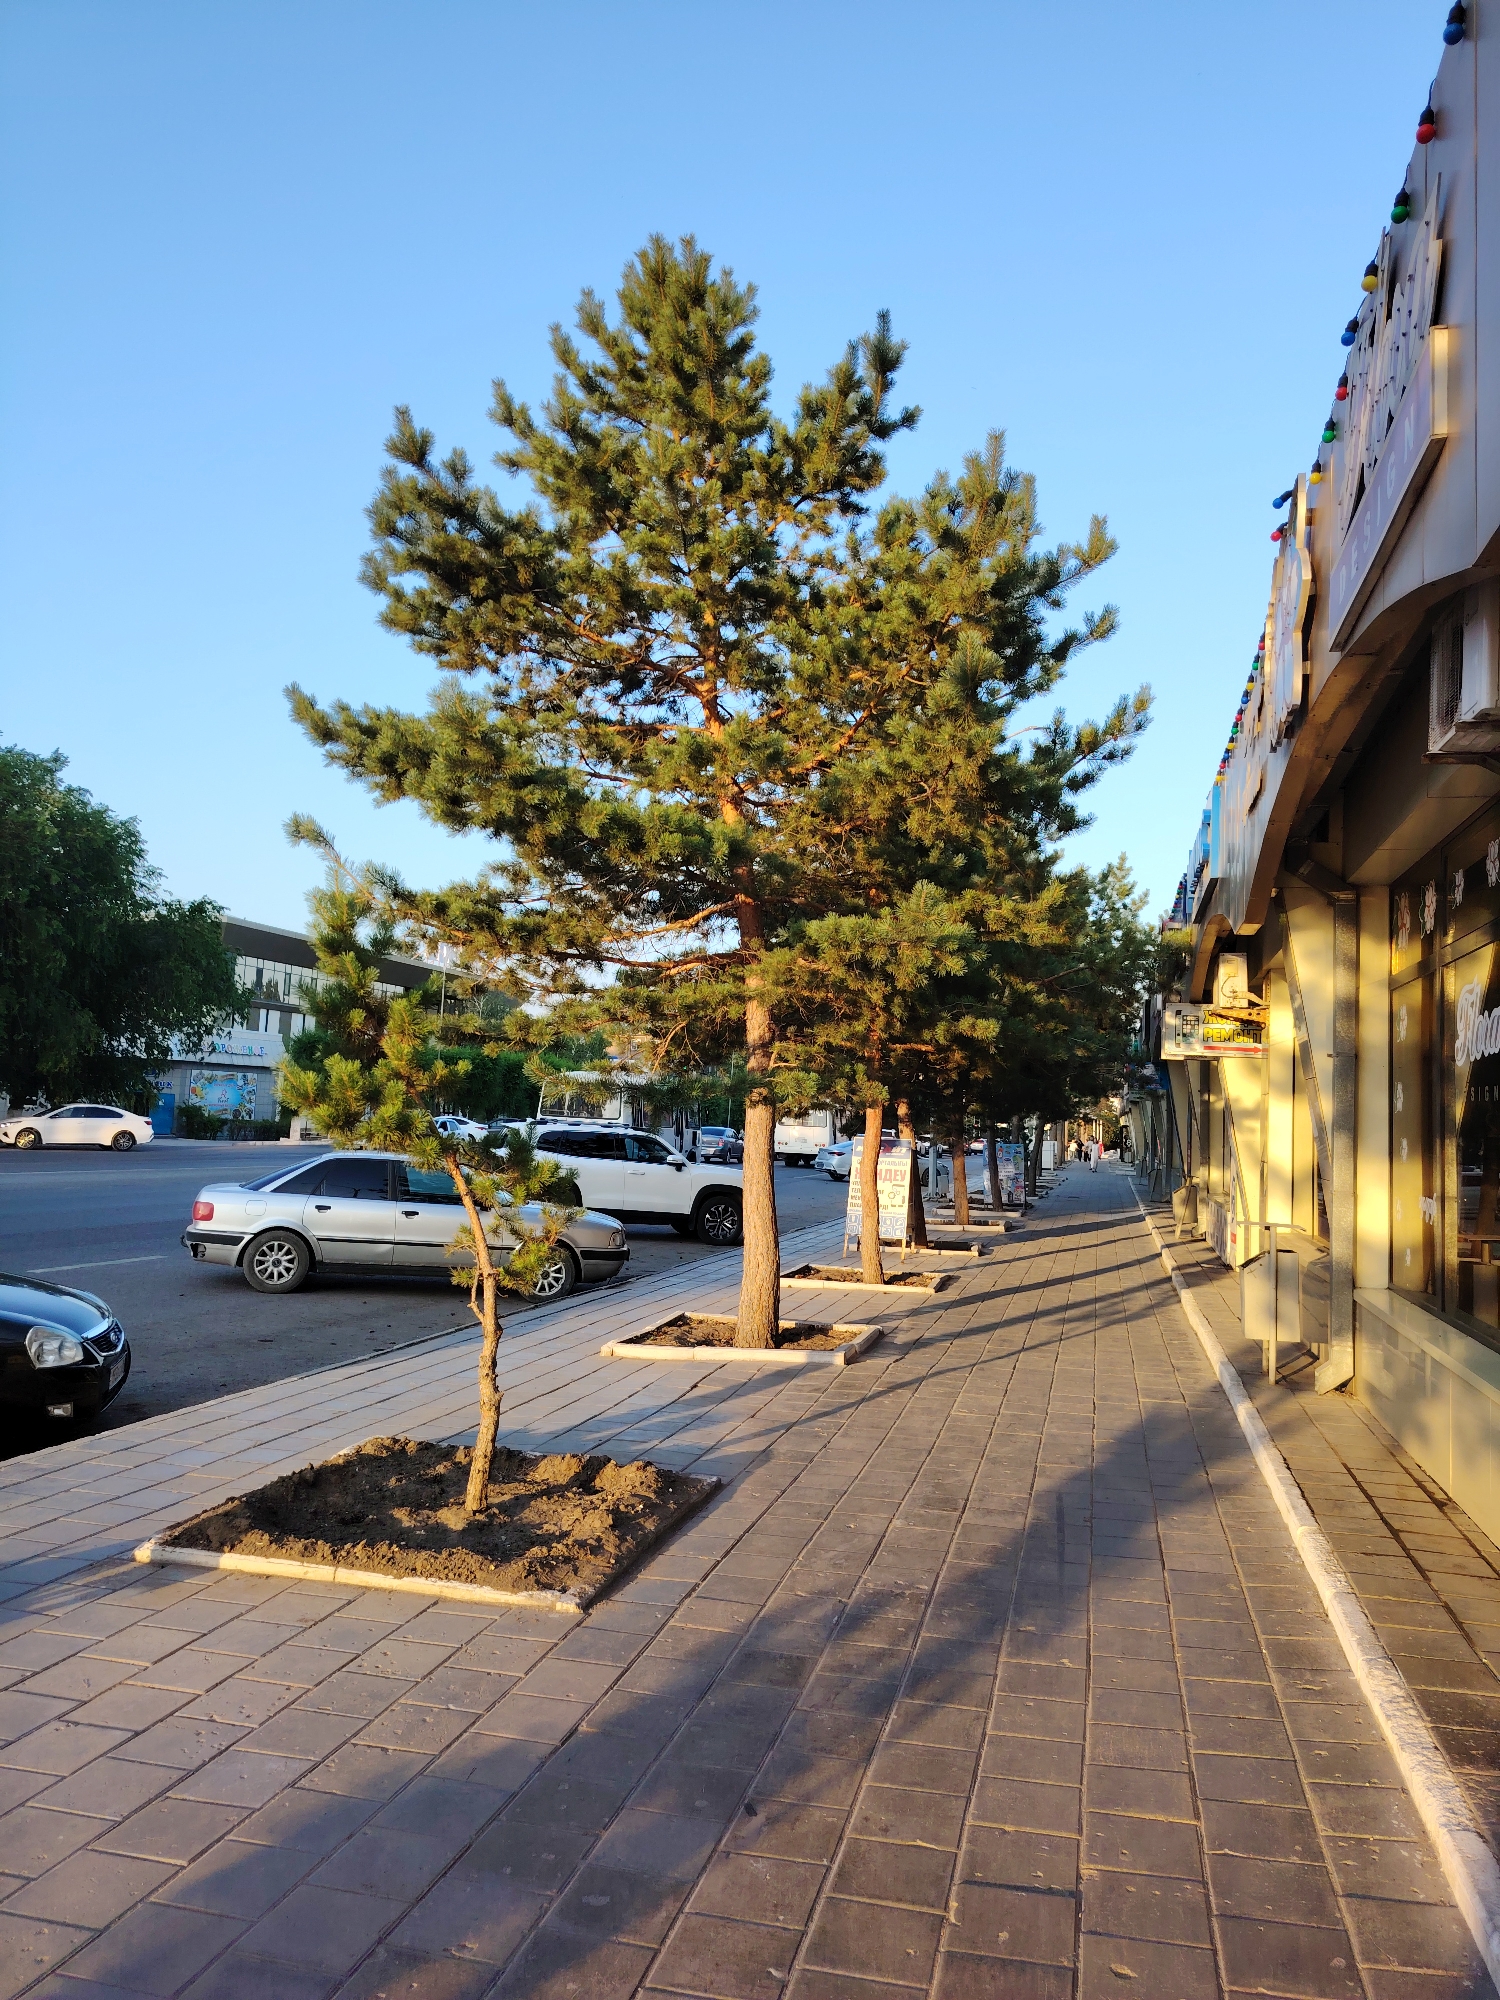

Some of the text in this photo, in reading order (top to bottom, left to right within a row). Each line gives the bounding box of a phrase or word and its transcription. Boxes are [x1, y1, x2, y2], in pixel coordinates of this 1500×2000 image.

[1338, 403, 1415, 605] DESIGN
[1203, 1027, 1262, 1044] РЕМОНТ
[1455, 1085, 1500, 1102] DSIGN
